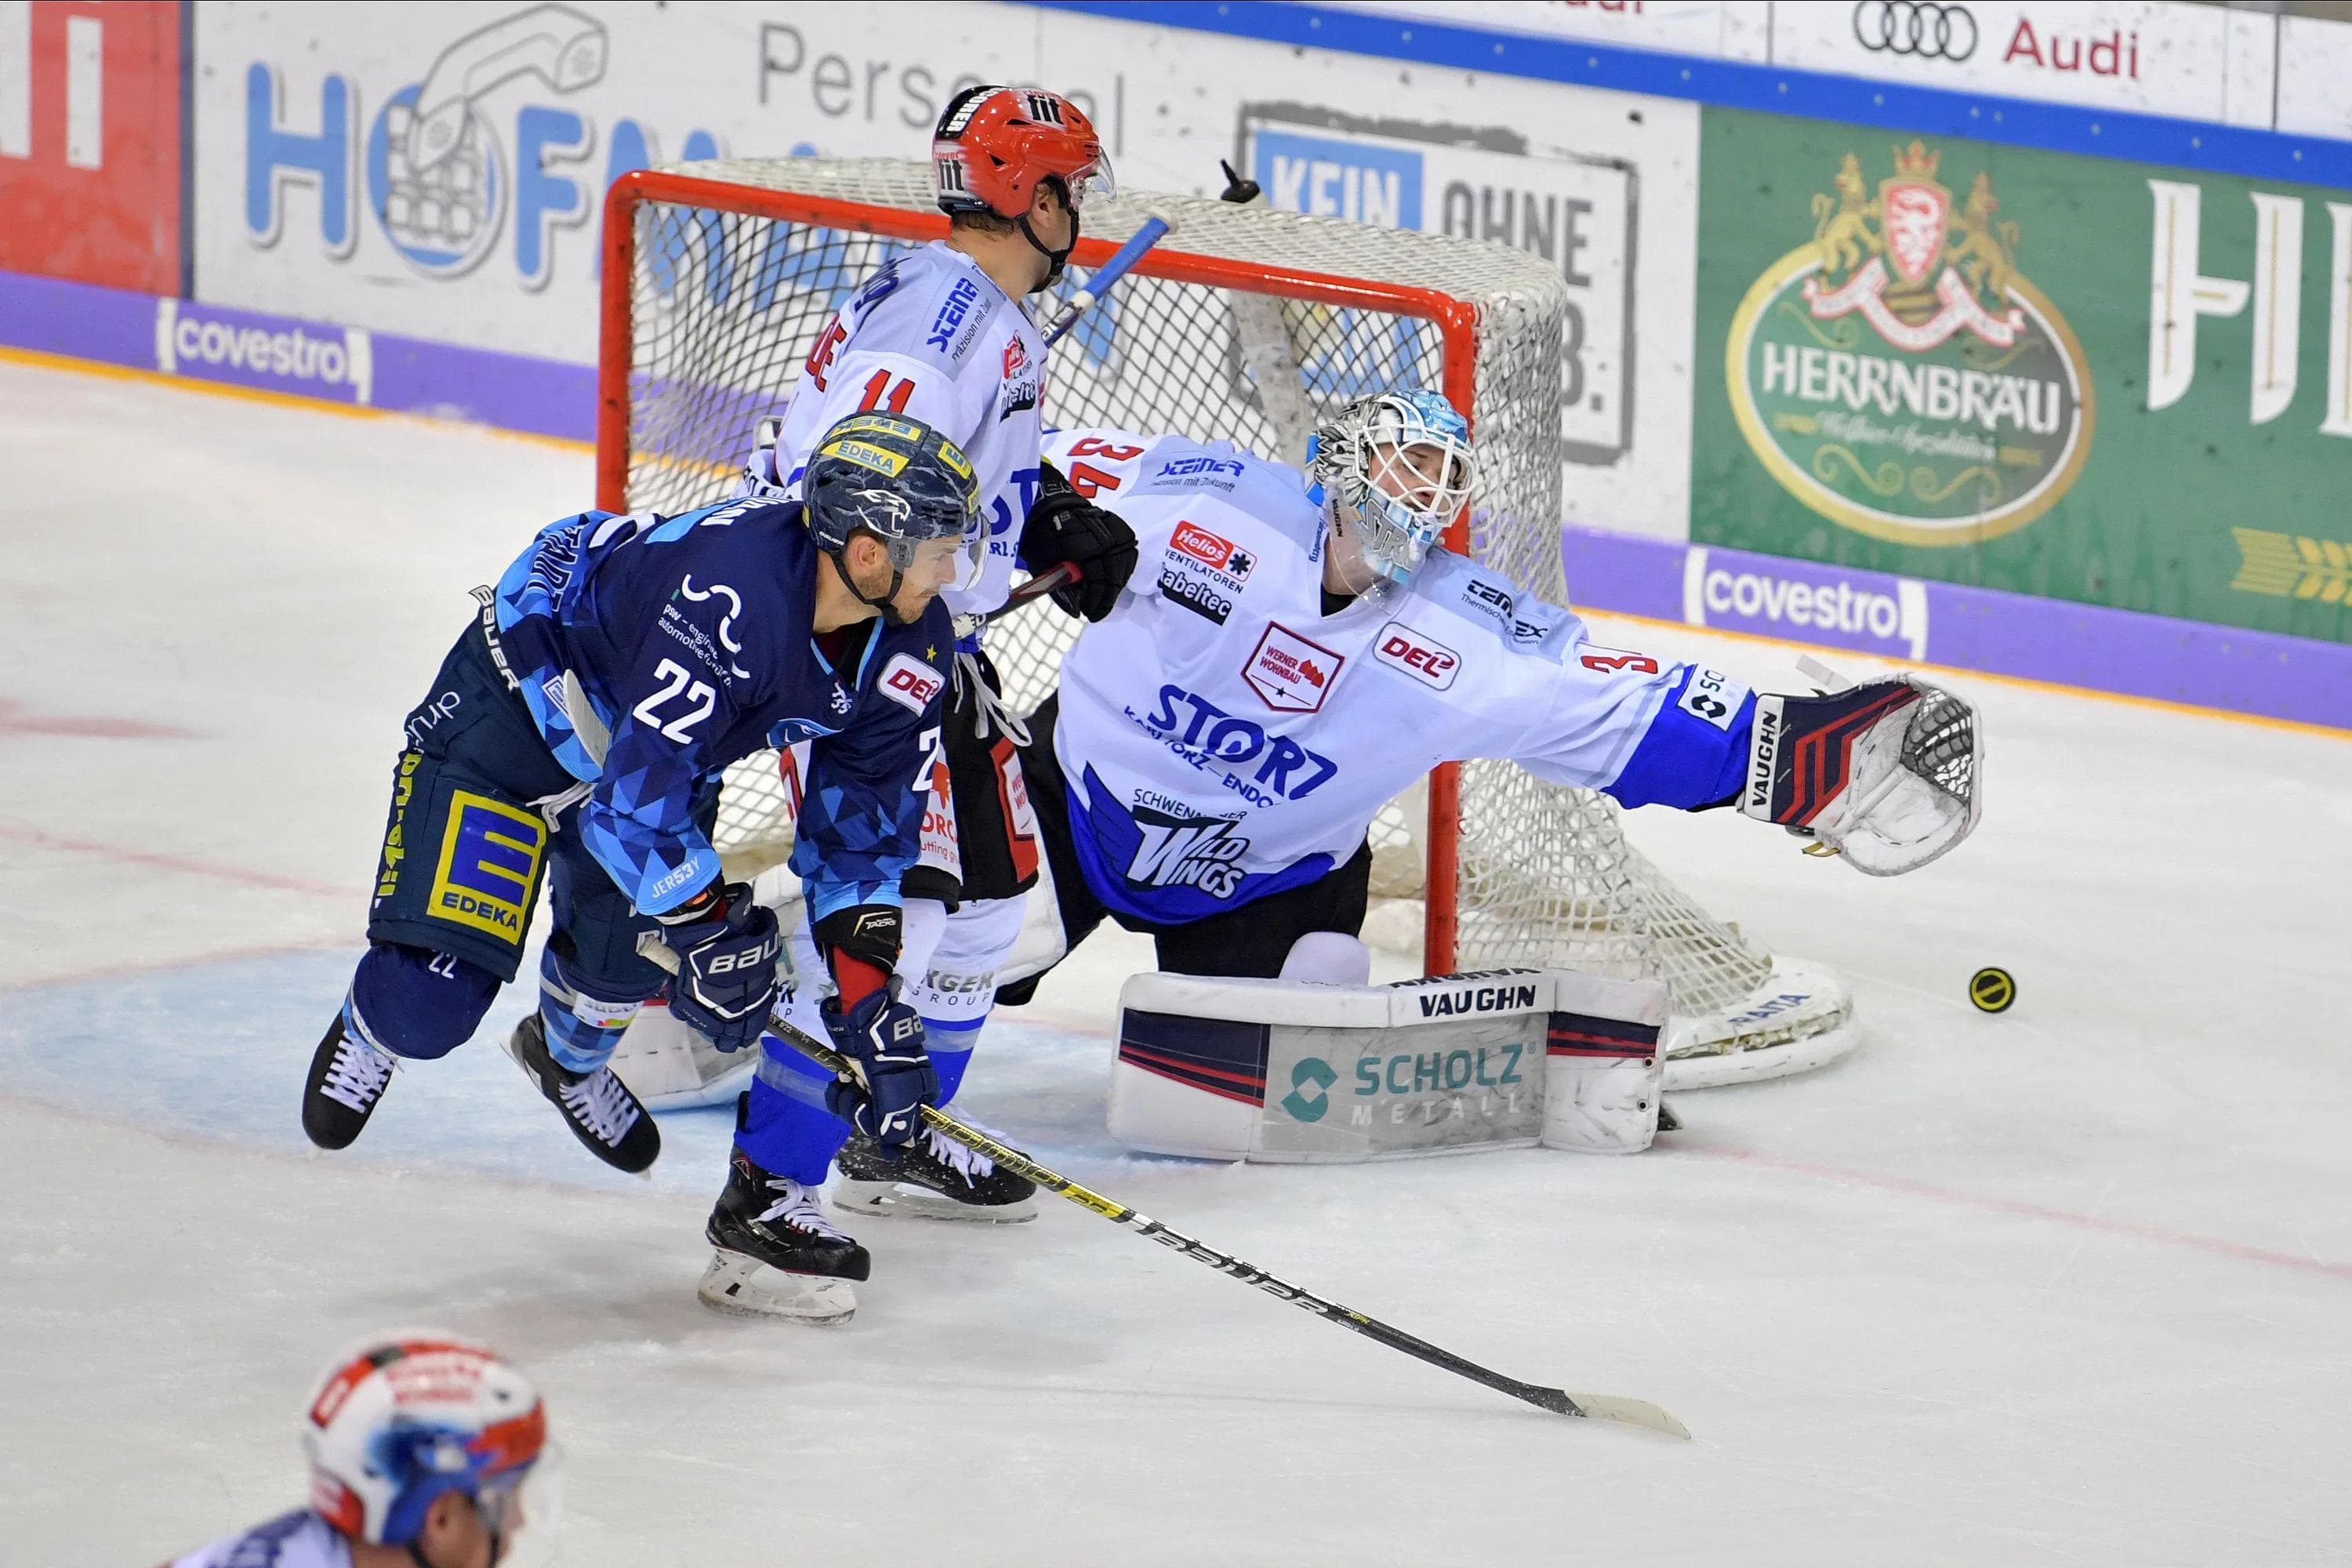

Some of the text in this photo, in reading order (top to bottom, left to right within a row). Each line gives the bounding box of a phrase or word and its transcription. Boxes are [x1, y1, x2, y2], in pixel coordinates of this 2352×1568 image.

[2003, 17, 2140, 78] Audi
[1443, 180, 1592, 288] OHNE
[176, 317, 347, 383] covestro
[857, 368, 916, 414] 11
[1762, 342, 2061, 434] HERRNBRÄU
[839, 441, 895, 471] EDEKA
[1176, 529, 1226, 559] Helios
[1164, 547, 1244, 594] VENTILATOREN
[1705, 568, 1898, 640] covestro
[1259, 655, 1302, 684] WOHNBAU
[1265, 644, 1299, 670] WERNER
[632, 657, 717, 745] 22
[1147, 684, 1338, 800] STORZ
[1752, 710, 1779, 808] VAUGHN
[441, 891, 519, 931] EDEKA
[1419, 985, 1537, 1017] VAUGHN
[1354, 1043, 1524, 1096] SCHOLZ
[1350, 1092, 1522, 1126] METALL
